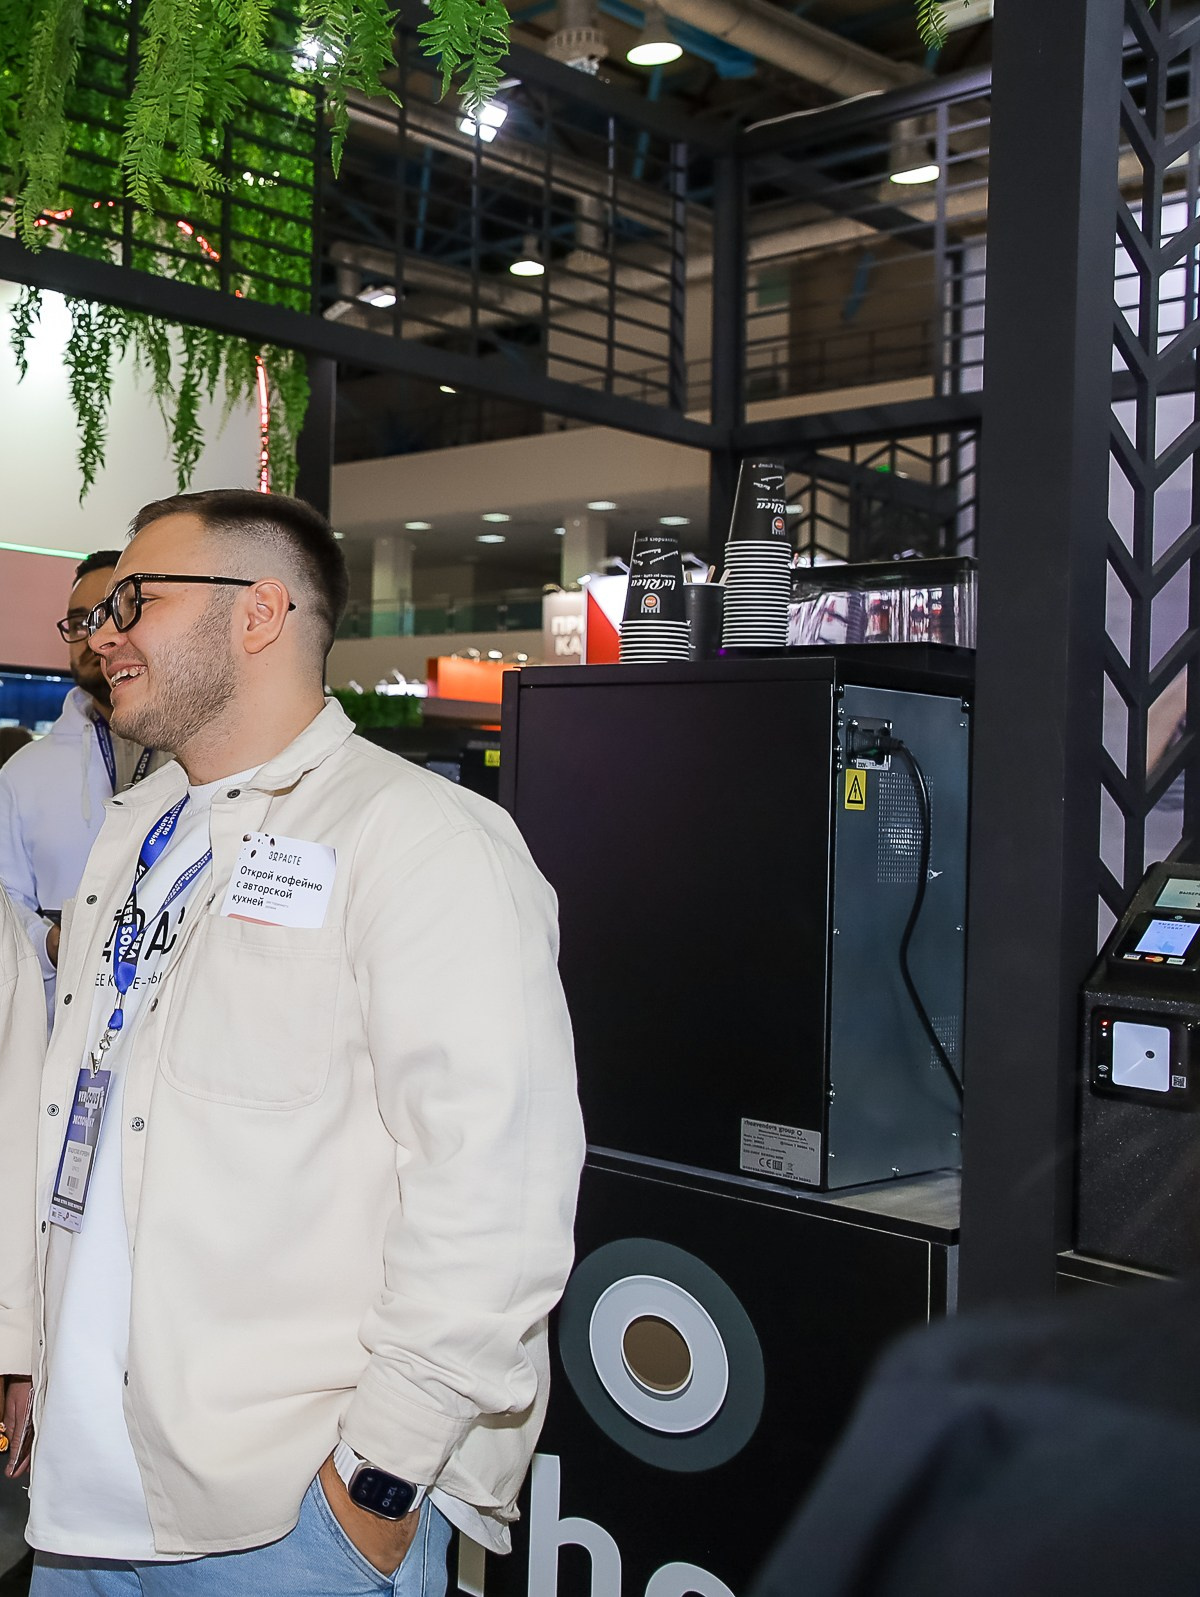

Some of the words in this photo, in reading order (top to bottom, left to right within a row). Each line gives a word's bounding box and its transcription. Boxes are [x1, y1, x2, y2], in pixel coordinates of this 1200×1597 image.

[240, 865, 274, 881] Открой
[275, 875, 323, 891] кофейню
[236, 880, 241, 888] с
[242, 881, 293, 899] авторской
[231, 893, 264, 907] кухней
